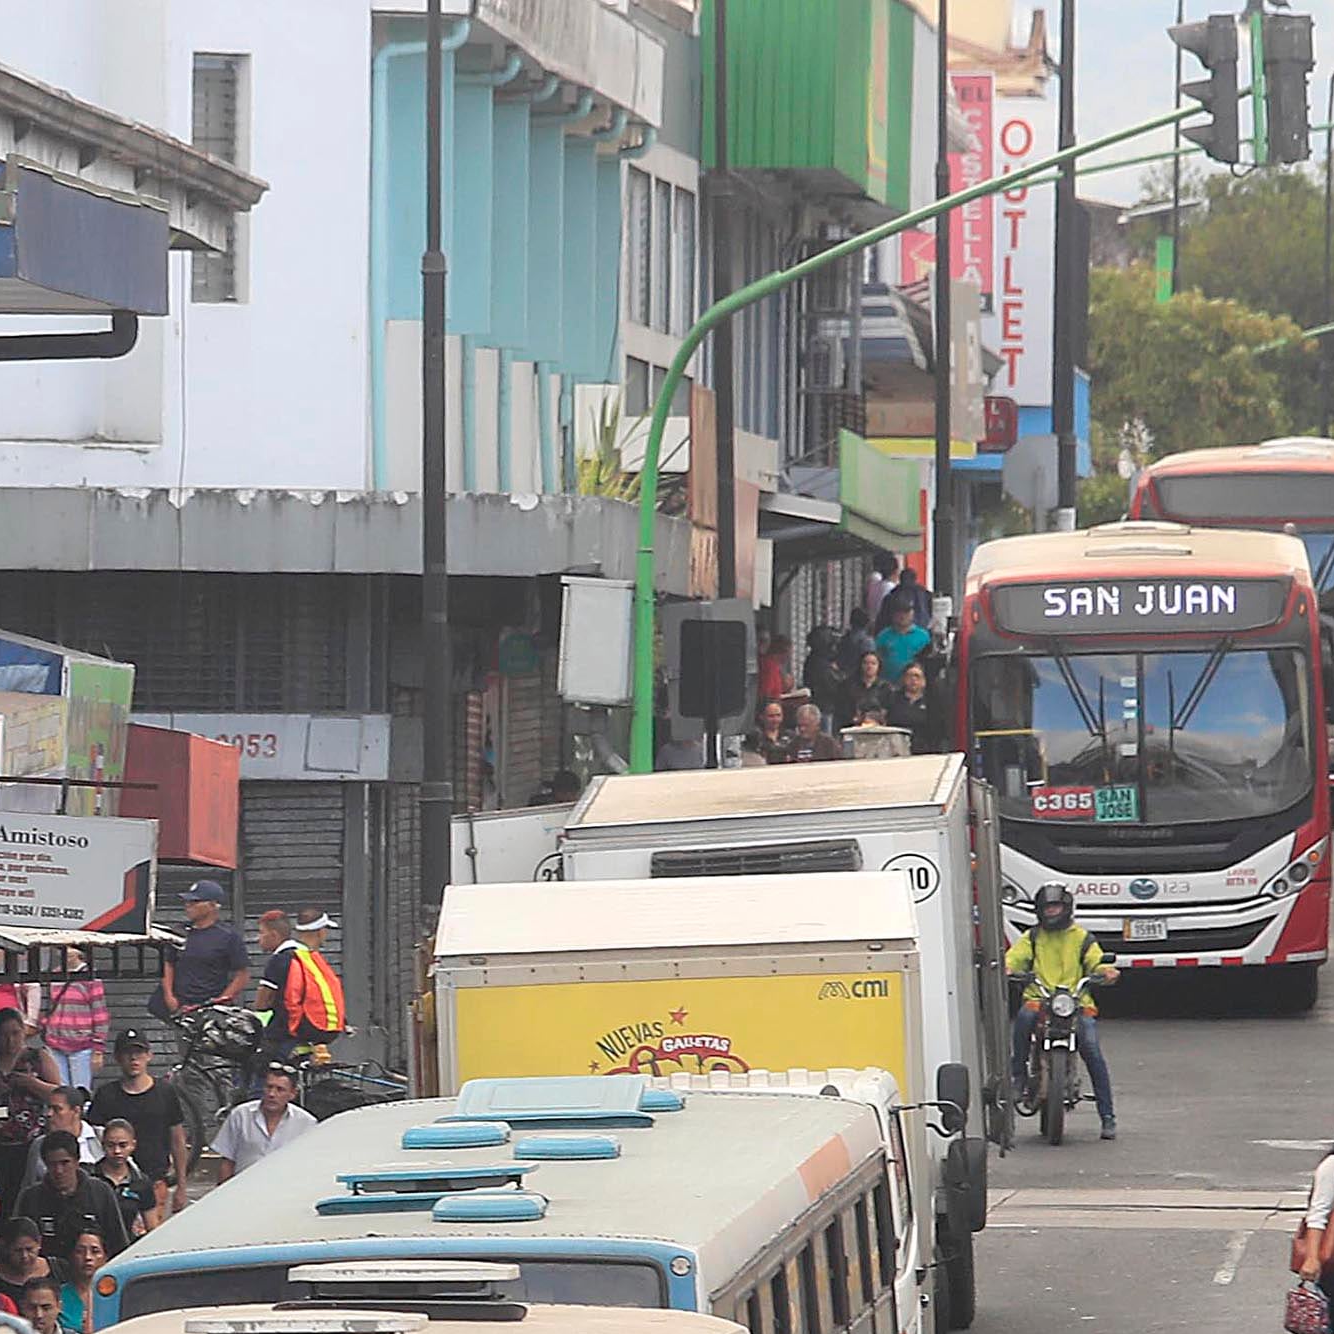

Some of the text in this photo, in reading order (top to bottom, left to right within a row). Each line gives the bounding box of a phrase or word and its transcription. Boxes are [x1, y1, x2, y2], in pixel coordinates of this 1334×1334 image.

[1000, 119, 1033, 388] OUTLET
[1043, 585, 1237, 618] SAN JUAN
[596, 1022, 664, 1063] NUEVAS
[662, 1036, 730, 1053] GALLETAS
